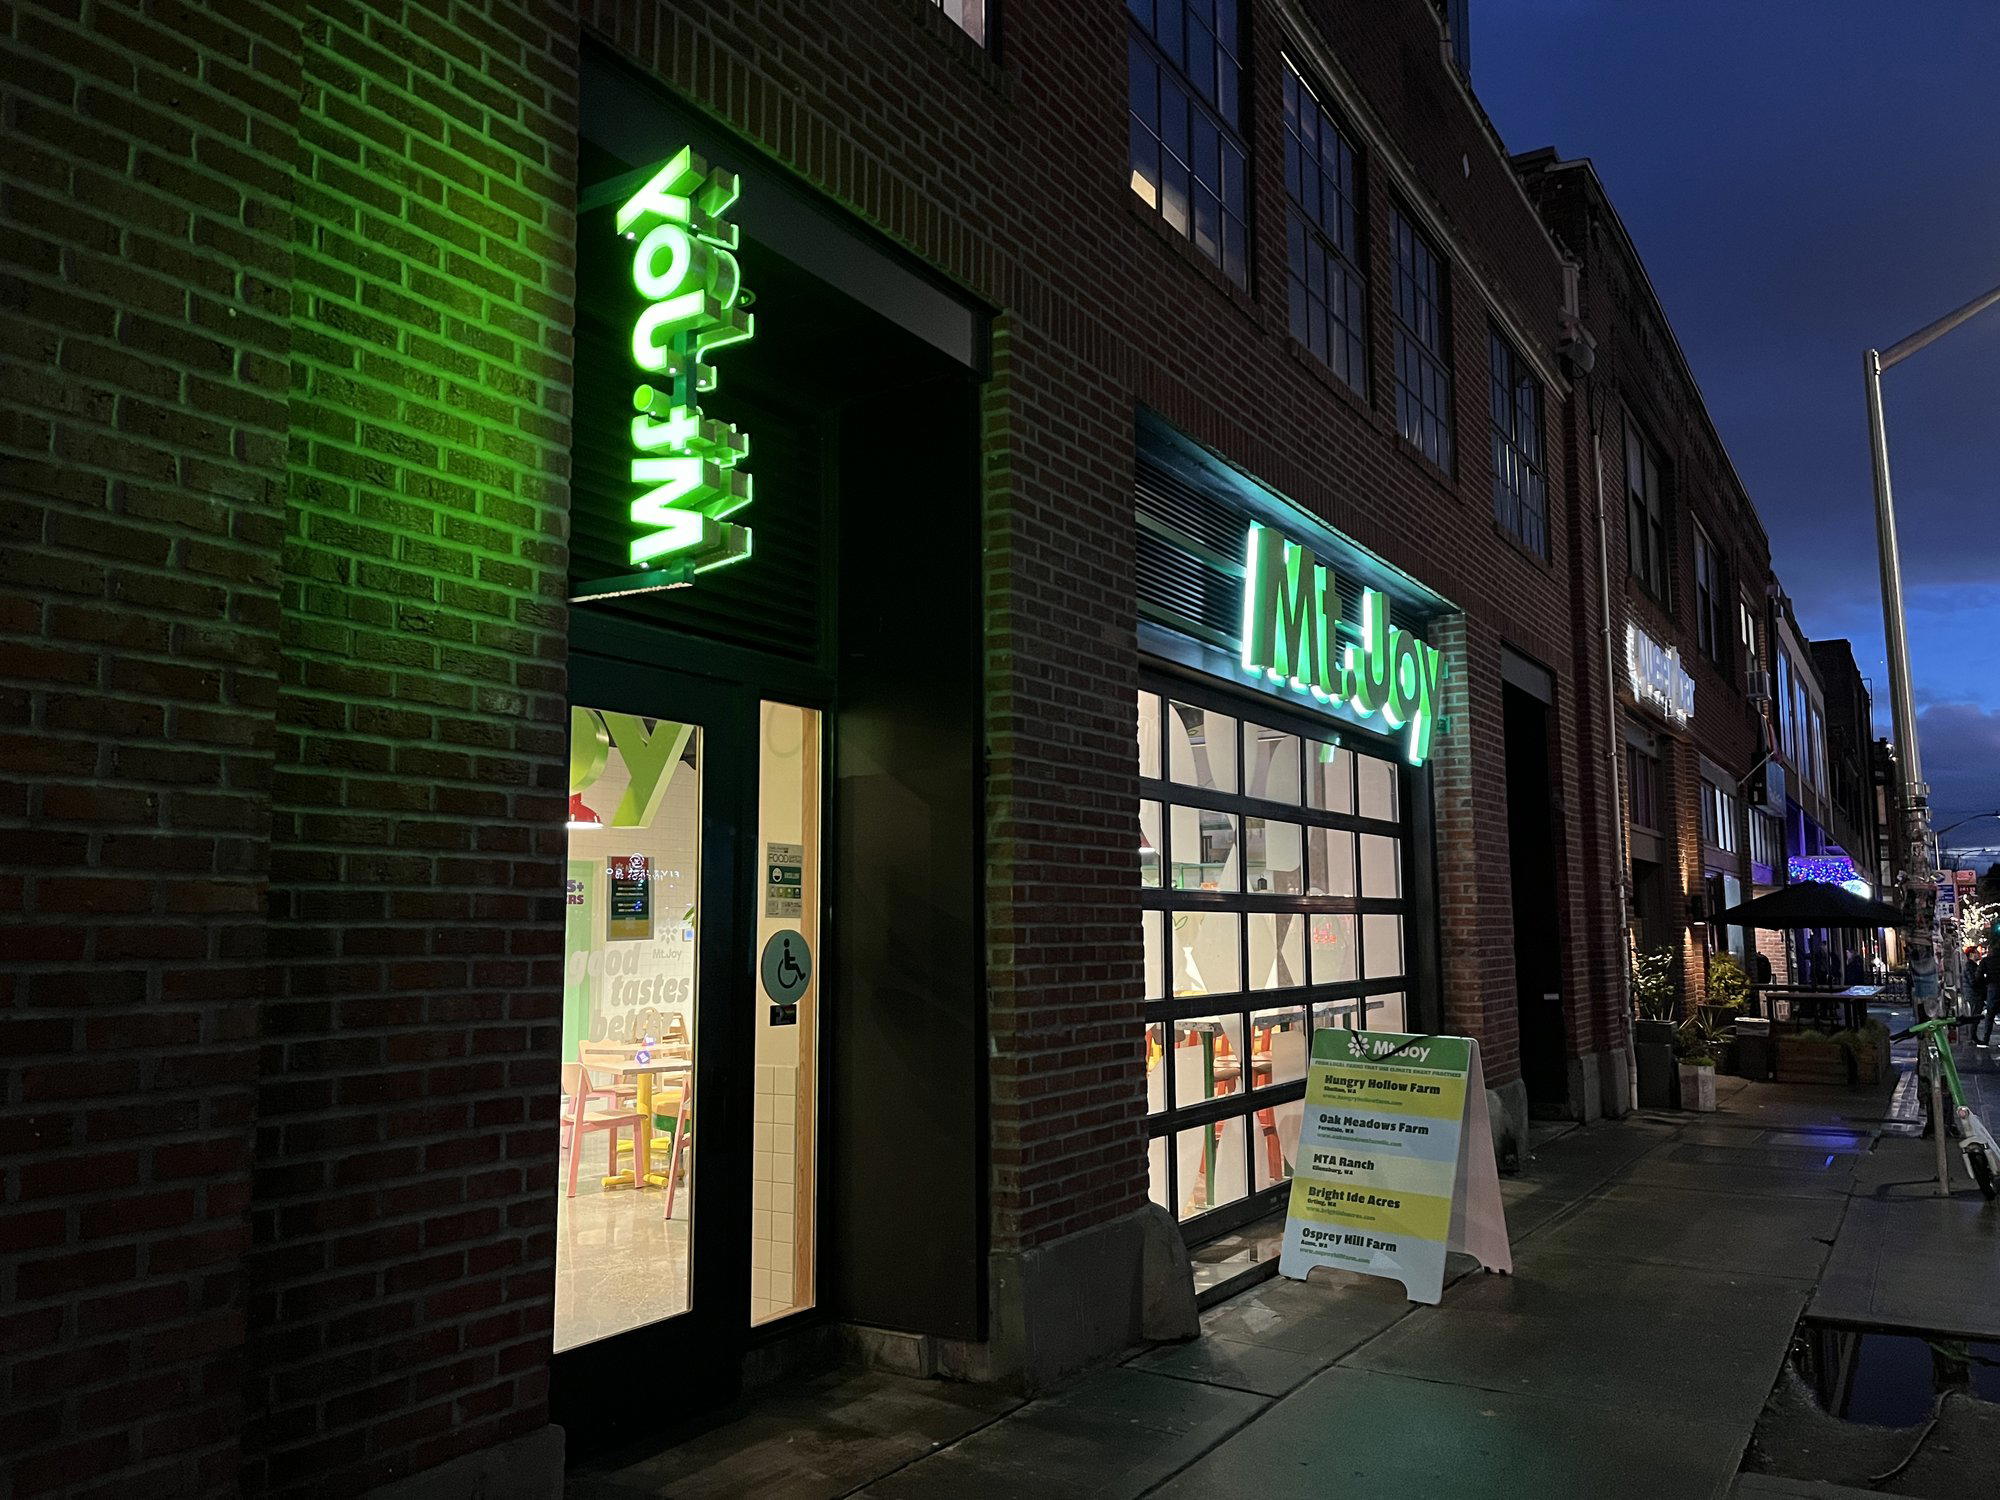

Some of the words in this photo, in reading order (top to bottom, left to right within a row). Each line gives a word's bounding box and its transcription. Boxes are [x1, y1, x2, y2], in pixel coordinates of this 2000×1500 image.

[615, 144, 708, 567] Mt.Joy
[1242, 521, 1443, 766] Mt.Joy
[768, 852, 790, 863] FOOD
[568, 943, 642, 987] good
[611, 973, 690, 1007] tastes
[1324, 1074, 1366, 1089] Hungry
[1368, 1077, 1408, 1092] Hollow
[1410, 1082, 1441, 1095] Farm
[1319, 1113, 1341, 1124] Oak
[1343, 1115, 1396, 1131] Meadows
[1398, 1122, 1429, 1135] Farm
[1313, 1153, 1337, 1165] MTA
[1338, 1156, 1375, 1170] Ranch
[1308, 1186, 1345, 1201] Bright
[1346, 1192, 1365, 1203] Ide
[1367, 1194, 1401, 1209] Acres
[1302, 1227, 1343, 1244] Osprey
[1344, 1234, 1364, 1247] Hill
[1366, 1238, 1397, 1252] Farm
